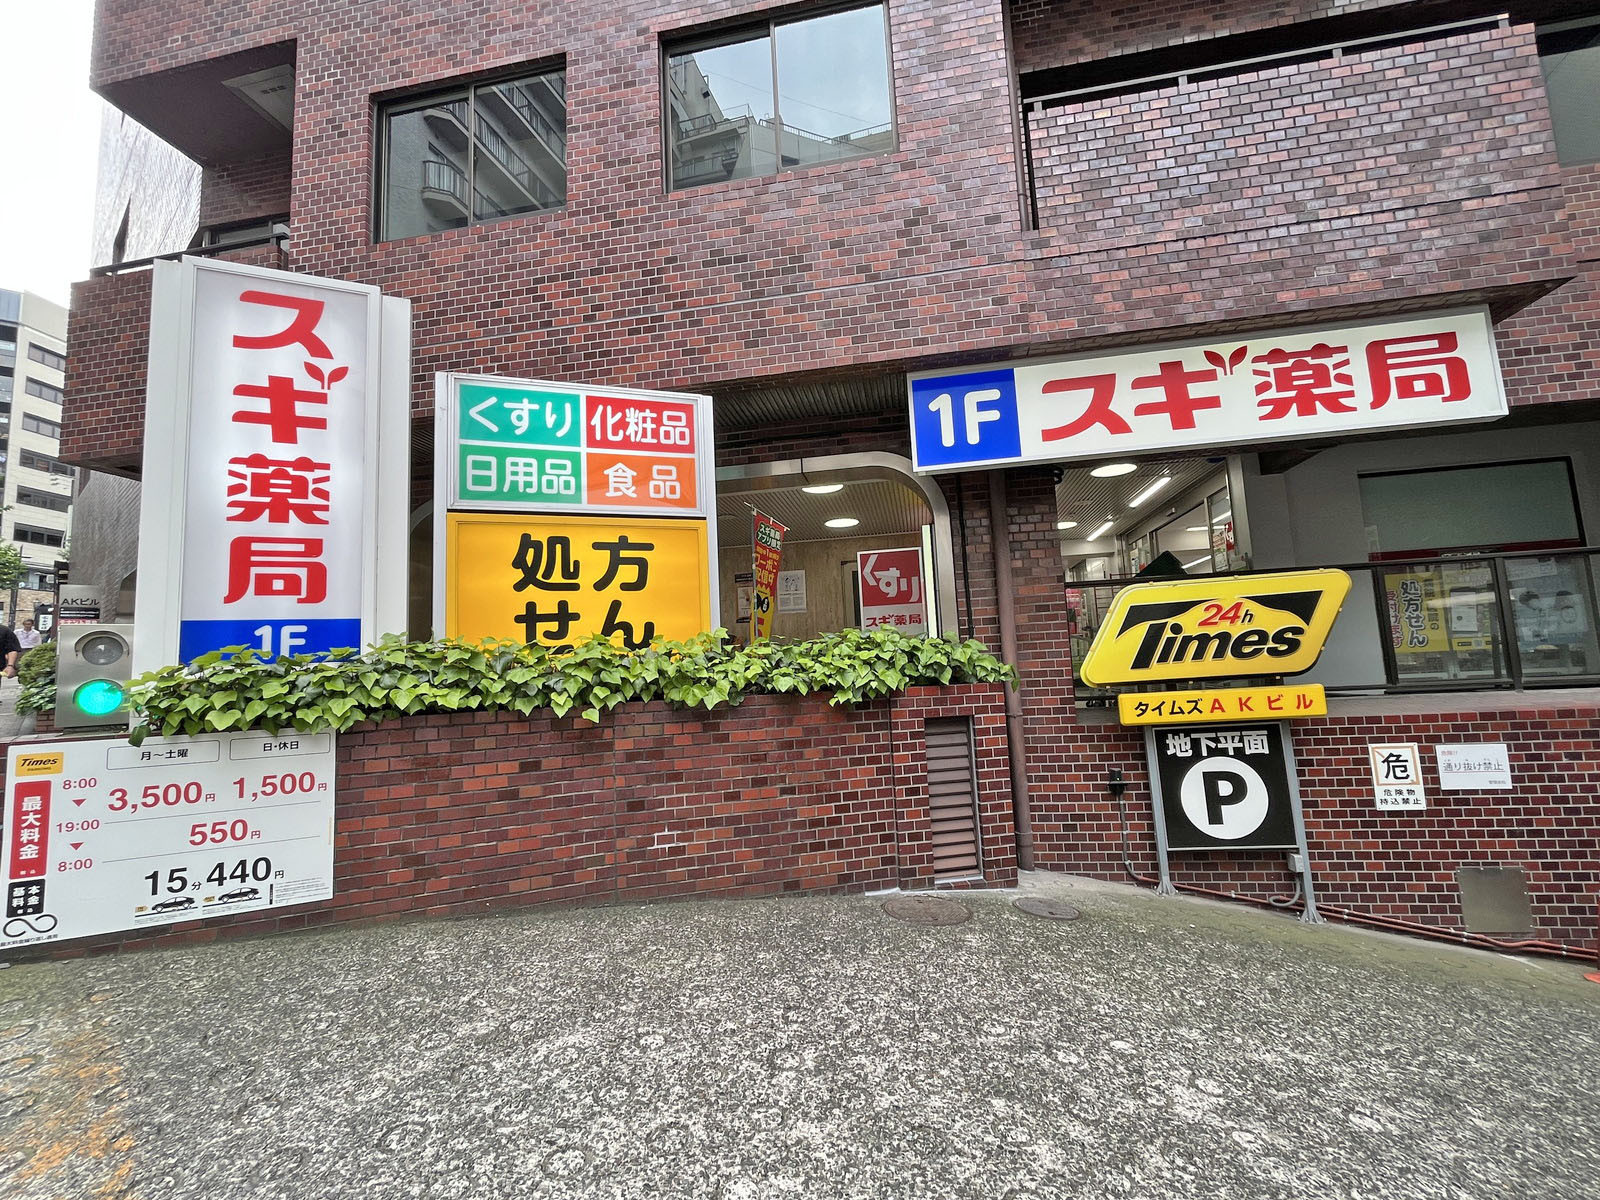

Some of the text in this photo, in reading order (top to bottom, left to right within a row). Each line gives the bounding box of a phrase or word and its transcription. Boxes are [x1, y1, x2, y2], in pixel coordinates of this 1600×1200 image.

[927, 331, 1472, 447] 1F スギ薬局
[468, 396, 572, 437] くすり
[590, 404, 690, 445] 化粧品
[223, 290, 350, 604] スギ薬局
[466, 454, 576, 495] 日用品
[603, 462, 681, 500] 食品
[511, 533, 655, 593] 処方
[863, 554, 920, 603] くすり
[61, 598, 100, 606] AKビル
[865, 613, 922, 628] スギ薬局
[1198, 602, 1254, 627] 24h
[1400, 578, 1429, 647] 処方せん
[253, 624, 308, 660] 1F
[513, 599, 655, 655] せん
[1129, 621, 1305, 670] Times
[1166, 730, 1270, 757] 地下平面
[21, 758, 58, 767] Times
[1381, 752, 1410, 780] 危
[1443, 759, 1504, 772] 通り抜け禁止
[62, 777, 97, 790] 8:00
[1202, 770, 1248, 825] P
[1379, 797, 1422, 806] 持込禁止
[1383, 788, 1416, 797] 危険物
[19, 795, 43, 860] 最大料金
[55, 819, 100, 833] 19:00
[57, 858, 93, 872] 8:00
